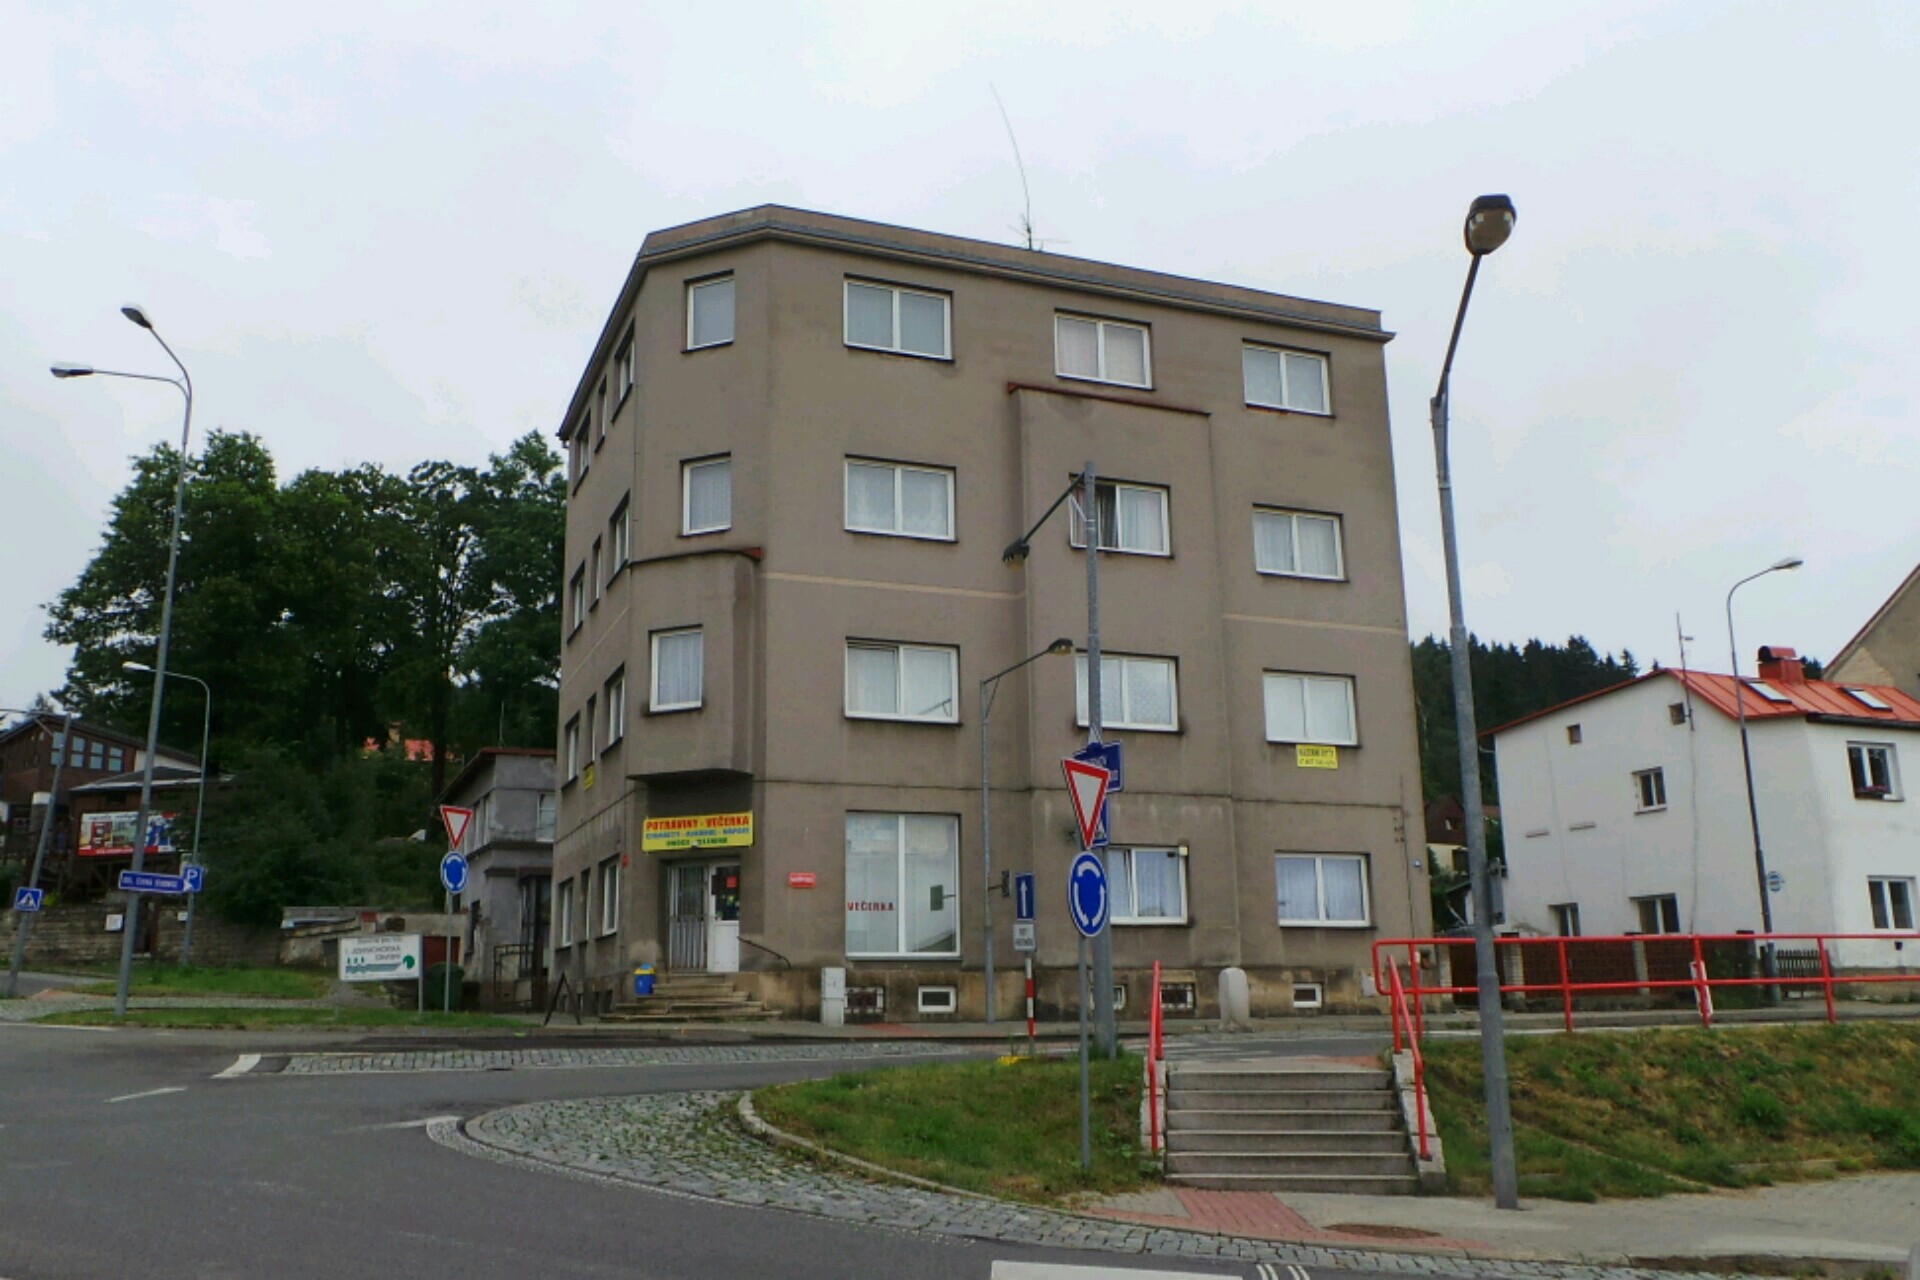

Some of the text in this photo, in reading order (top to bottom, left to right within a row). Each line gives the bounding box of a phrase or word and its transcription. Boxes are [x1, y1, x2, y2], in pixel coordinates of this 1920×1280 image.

[646, 815, 749, 831] POTRAVINY VEČERKA
[847, 901, 895, 912] VEČERKA
